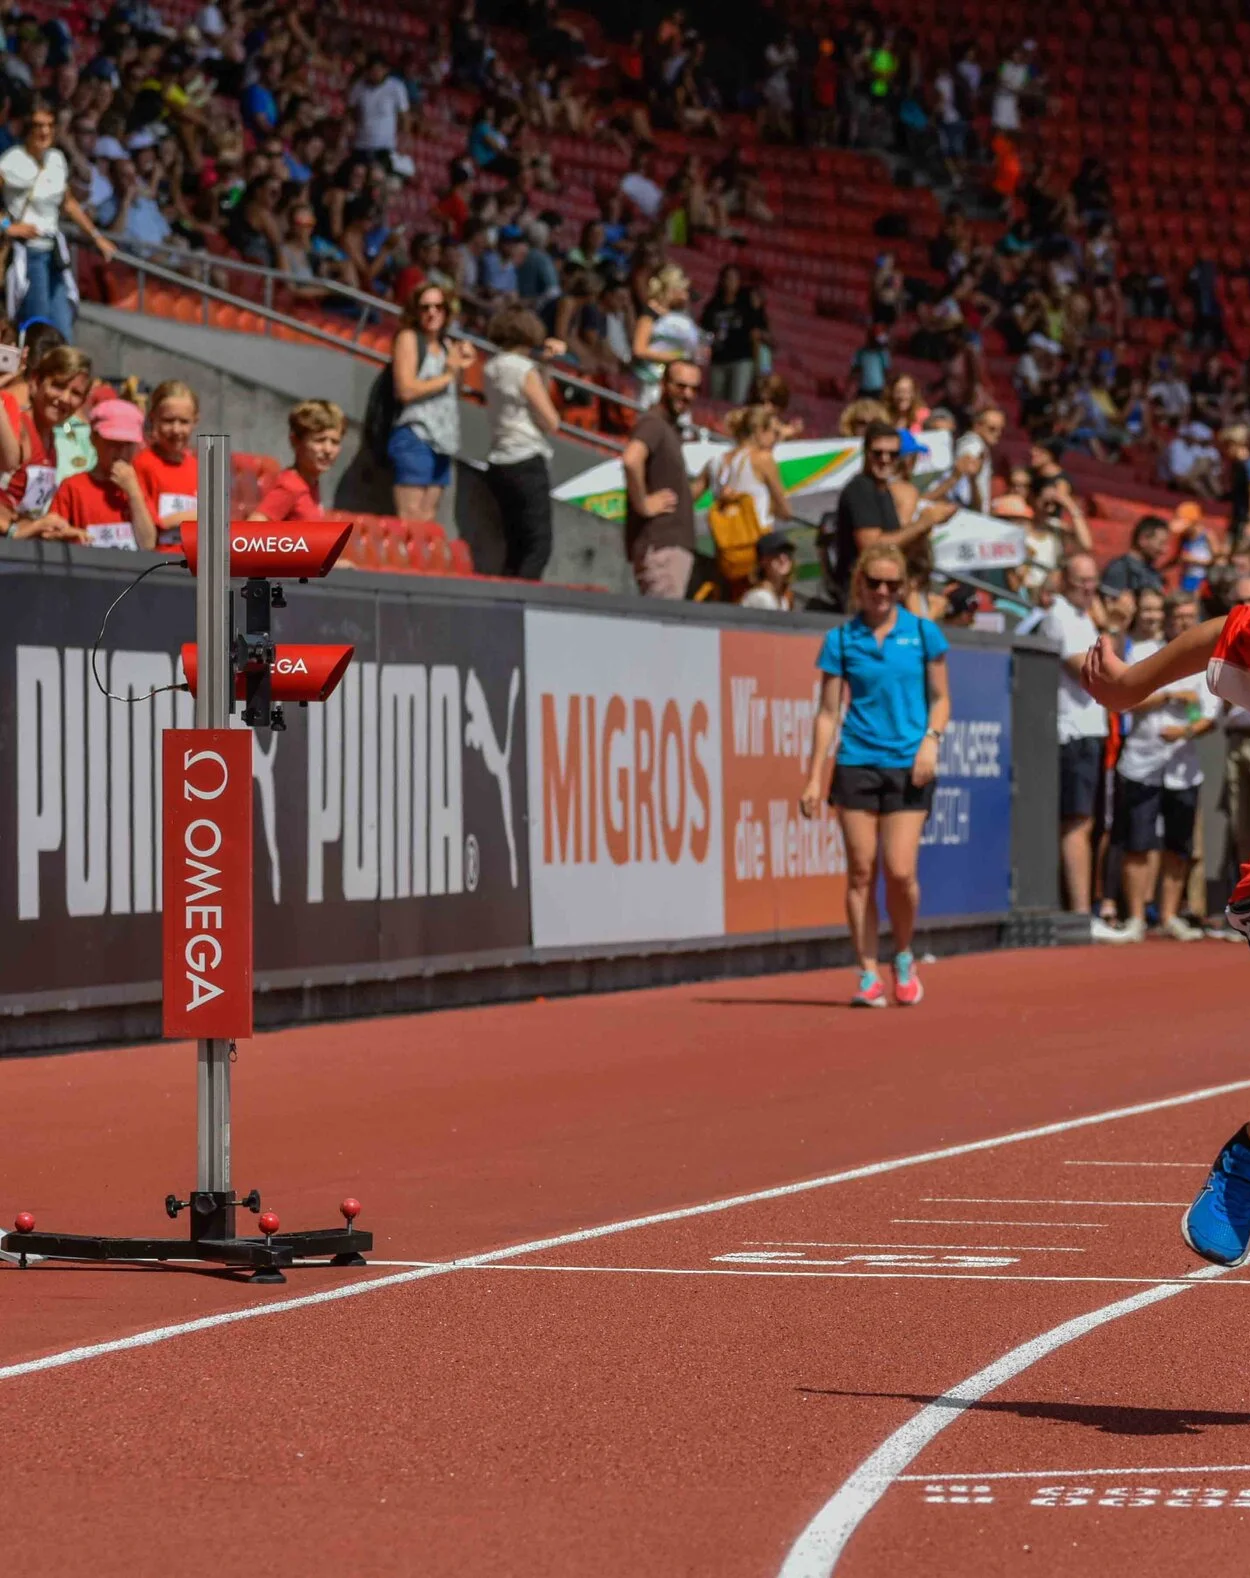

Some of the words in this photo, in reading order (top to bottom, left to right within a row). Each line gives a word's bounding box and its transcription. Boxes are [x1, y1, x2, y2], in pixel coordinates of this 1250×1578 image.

[232, 536, 310, 553] OMEGA
[16, 645, 197, 920] PUM
[306, 661, 463, 903] PUMA
[540, 692, 711, 866] MIGROS
[184, 819, 225, 1012] OMEGA
